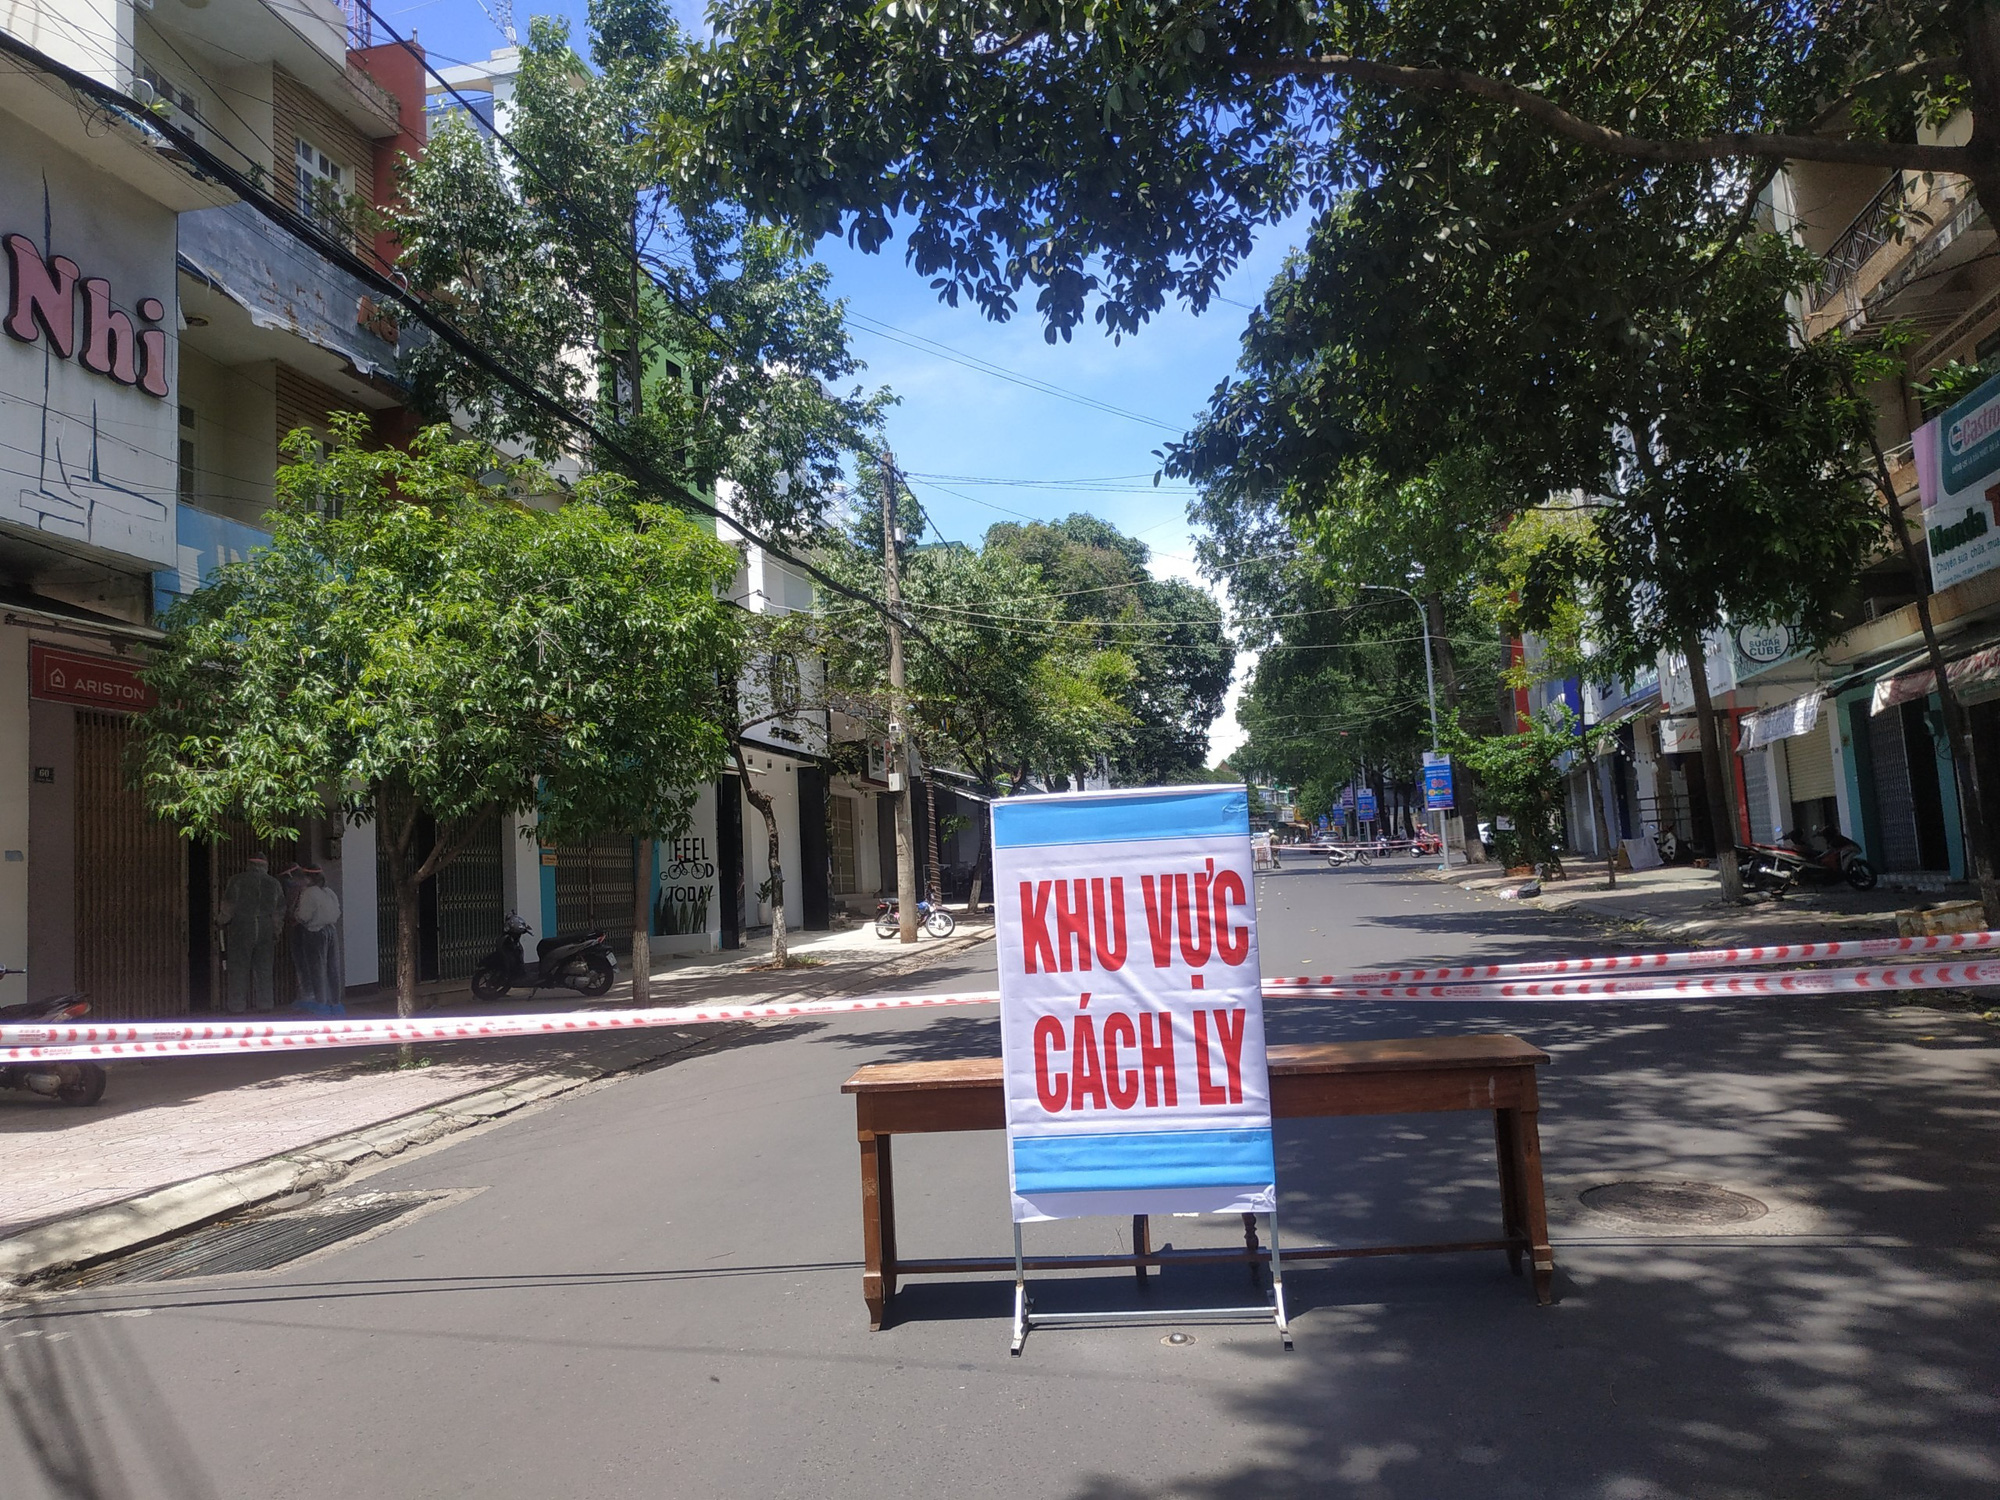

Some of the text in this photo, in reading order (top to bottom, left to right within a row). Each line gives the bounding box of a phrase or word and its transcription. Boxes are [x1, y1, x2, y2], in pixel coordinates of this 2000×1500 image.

[3, 232, 169, 398] Nhi
[1929, 507, 1988, 557] Honda
[1749, 639, 1780, 648] SUGAR
[1749, 646, 1781, 656] CUBE
[74, 678, 145, 700] ARISTON
[674, 838, 709, 862] FEEL
[666, 884, 714, 902] TODAY
[1019, 857, 1249, 990] KHU VỰC
[1033, 992, 1245, 1113] CÁCH LY
